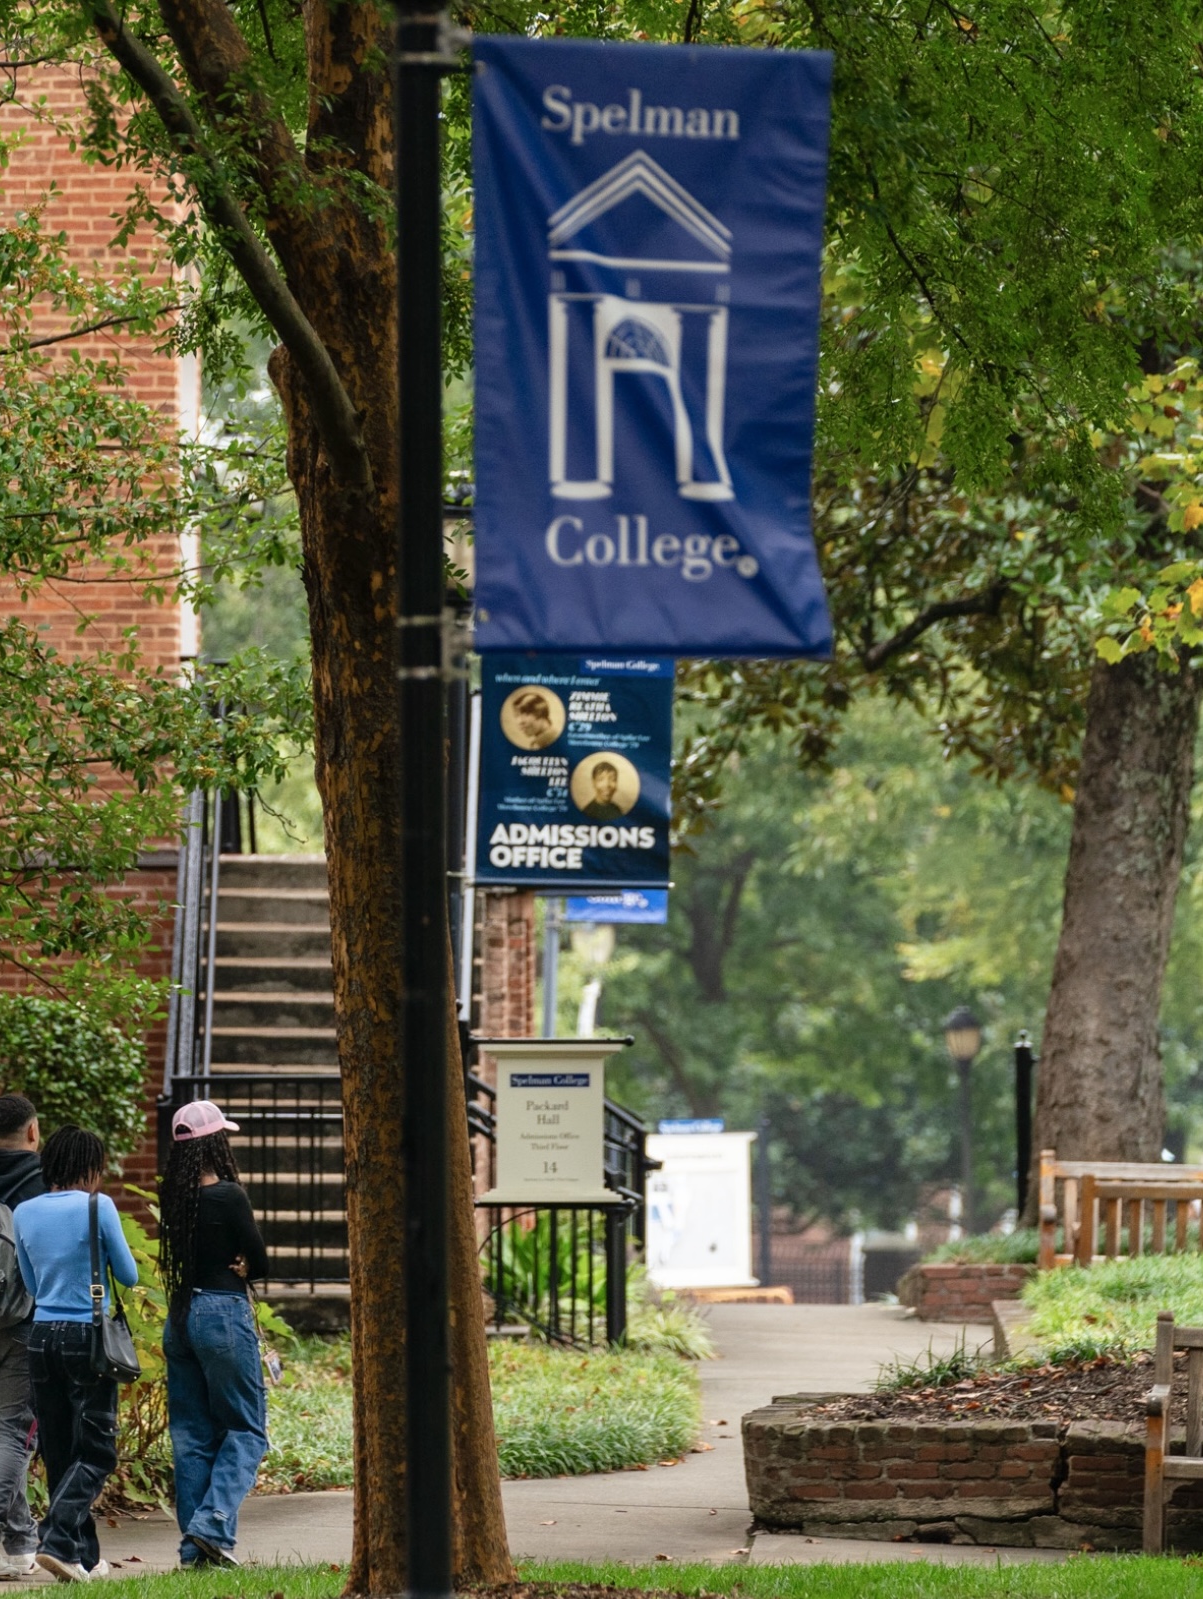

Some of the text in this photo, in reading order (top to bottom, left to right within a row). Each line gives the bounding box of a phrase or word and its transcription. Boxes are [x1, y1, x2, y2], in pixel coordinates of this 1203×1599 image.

[541, 84, 741, 145] Spelman
[585, 659, 625, 671] Spelman
[489, 823, 656, 849] ADMISSIONS
[489, 845, 583, 869] OFFICE
[511, 1074, 588, 1086] Spelman College
[526, 1101, 569, 1111] Packard
[536, 1114, 560, 1125] Hall
[543, 1161, 558, 1174] 14
